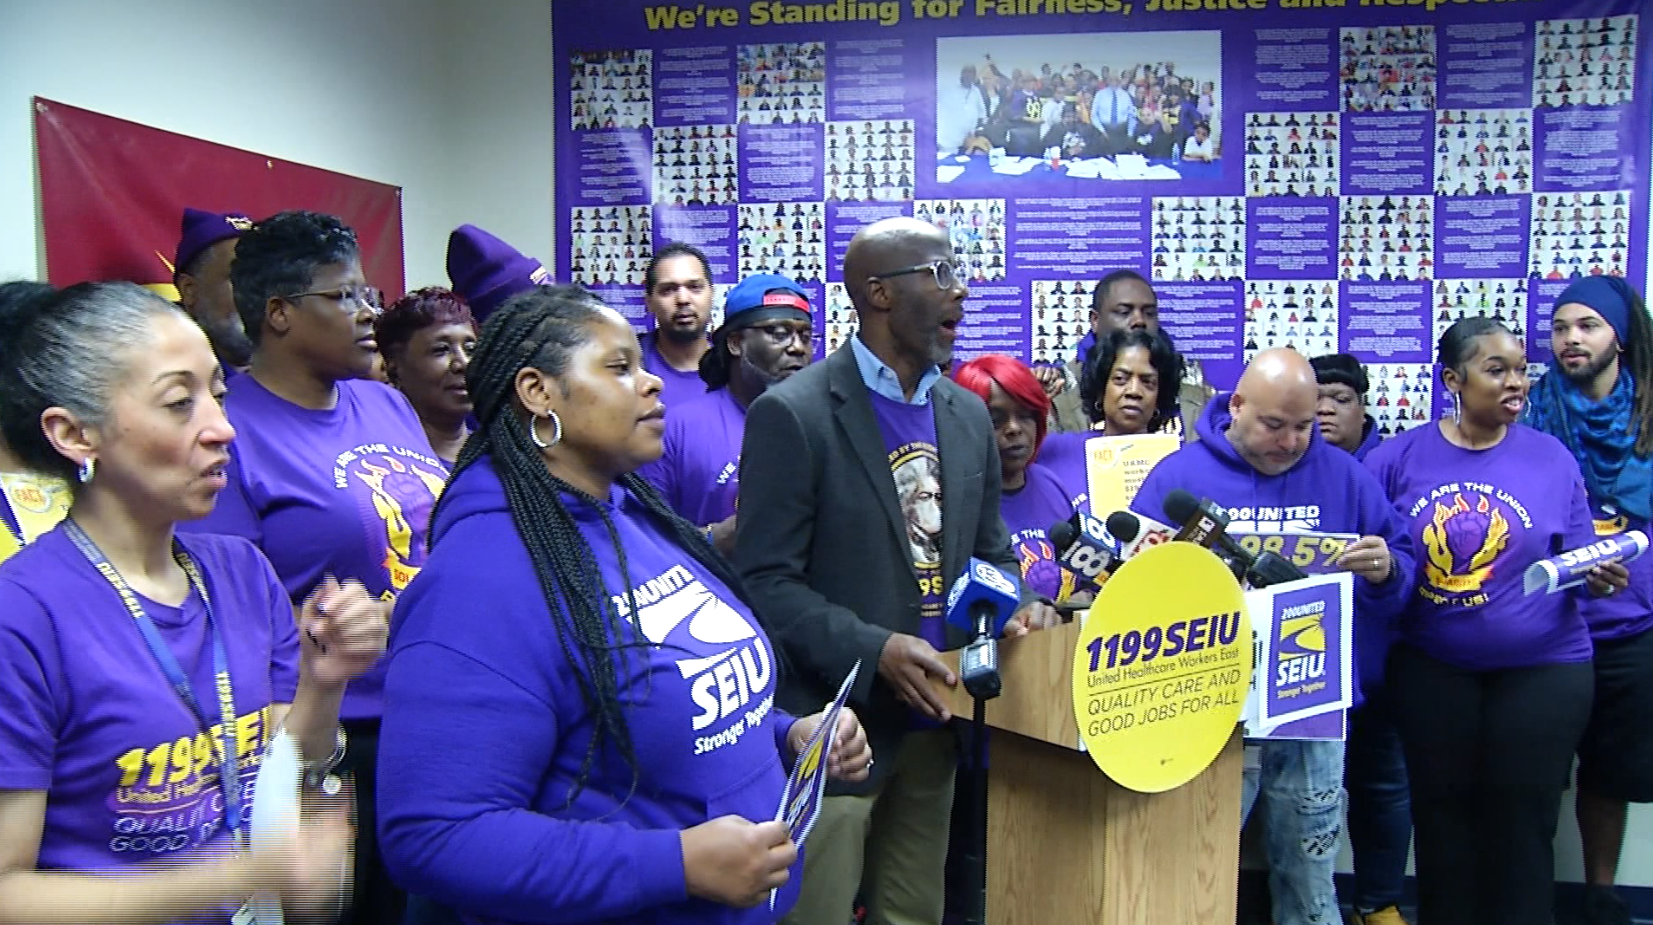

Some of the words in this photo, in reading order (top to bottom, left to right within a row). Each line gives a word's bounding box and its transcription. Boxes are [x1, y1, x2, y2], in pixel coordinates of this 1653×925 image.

[645, 4, 738, 29] We're
[750, 0, 899, 26] Standing
[912, 0, 964, 18] for
[975, 0, 1131, 15] Fairness,
[354, 443, 390, 455] THE
[717, 461, 737, 484] WE
[1409, 497, 1429, 517] WE
[1431, 482, 1460, 500] ARE
[1463, 482, 1494, 494] THE
[1496, 489, 1533, 529] UNION
[1021, 528, 1046, 539] THE
[1086, 611, 1241, 672] 1199SEIU
[691, 637, 771, 730] SEIU
[1087, 668, 1121, 688] United
[1123, 661, 1176, 681] Healthcare
[1178, 652, 1218, 669] Workers
[1220, 648, 1240, 661] East
[1276, 652, 1325, 687] SEIU
[1088, 686, 1158, 716] QUALITY
[1162, 676, 1205, 699] CARE
[1207, 670, 1241, 690] AND
[1088, 712, 1135, 737] GOOD
[1138, 702, 1177, 726] JOBS
[1180, 695, 1211, 715] FOR
[1213, 688, 1239, 708] ALL
[116, 704, 272, 786] 1199SEI
[694, 718, 745, 755] Stronger
[109, 834, 190, 852] GOOD
